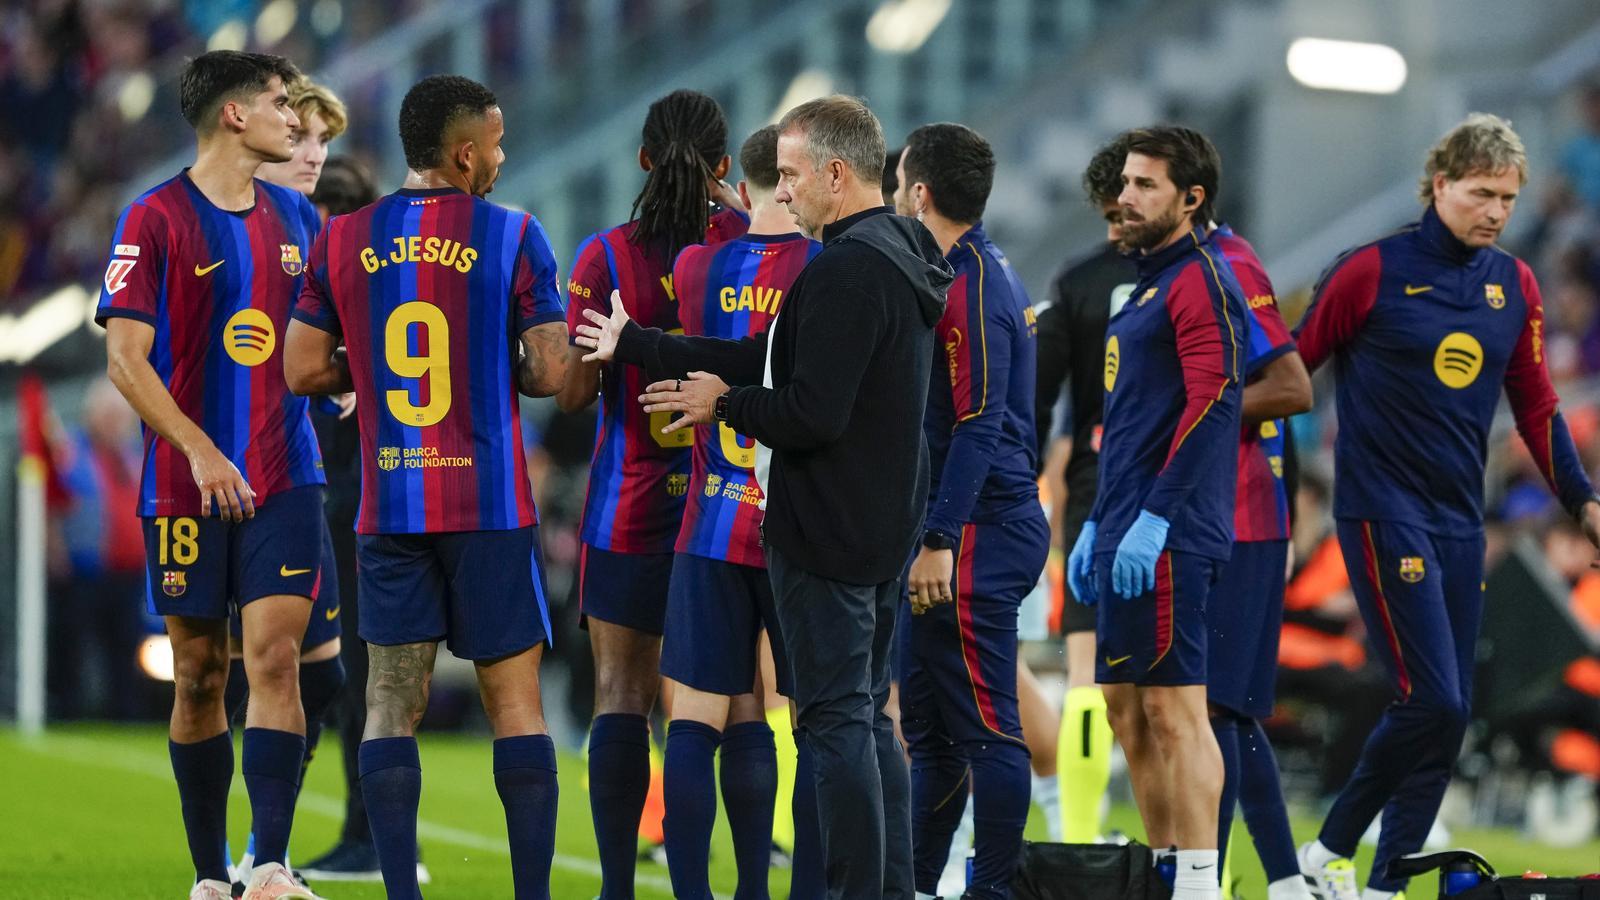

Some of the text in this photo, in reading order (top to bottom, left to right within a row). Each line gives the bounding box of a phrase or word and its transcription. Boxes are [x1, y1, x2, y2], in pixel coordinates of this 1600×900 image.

[720, 285, 783, 315] GAVI
[385, 301, 452, 427] 9
[403, 447, 439, 458] BARÇA
[404, 457, 472, 469] FOUNDATION
[725, 482, 760, 496] BARÇA
[154, 516, 199, 565] 18
